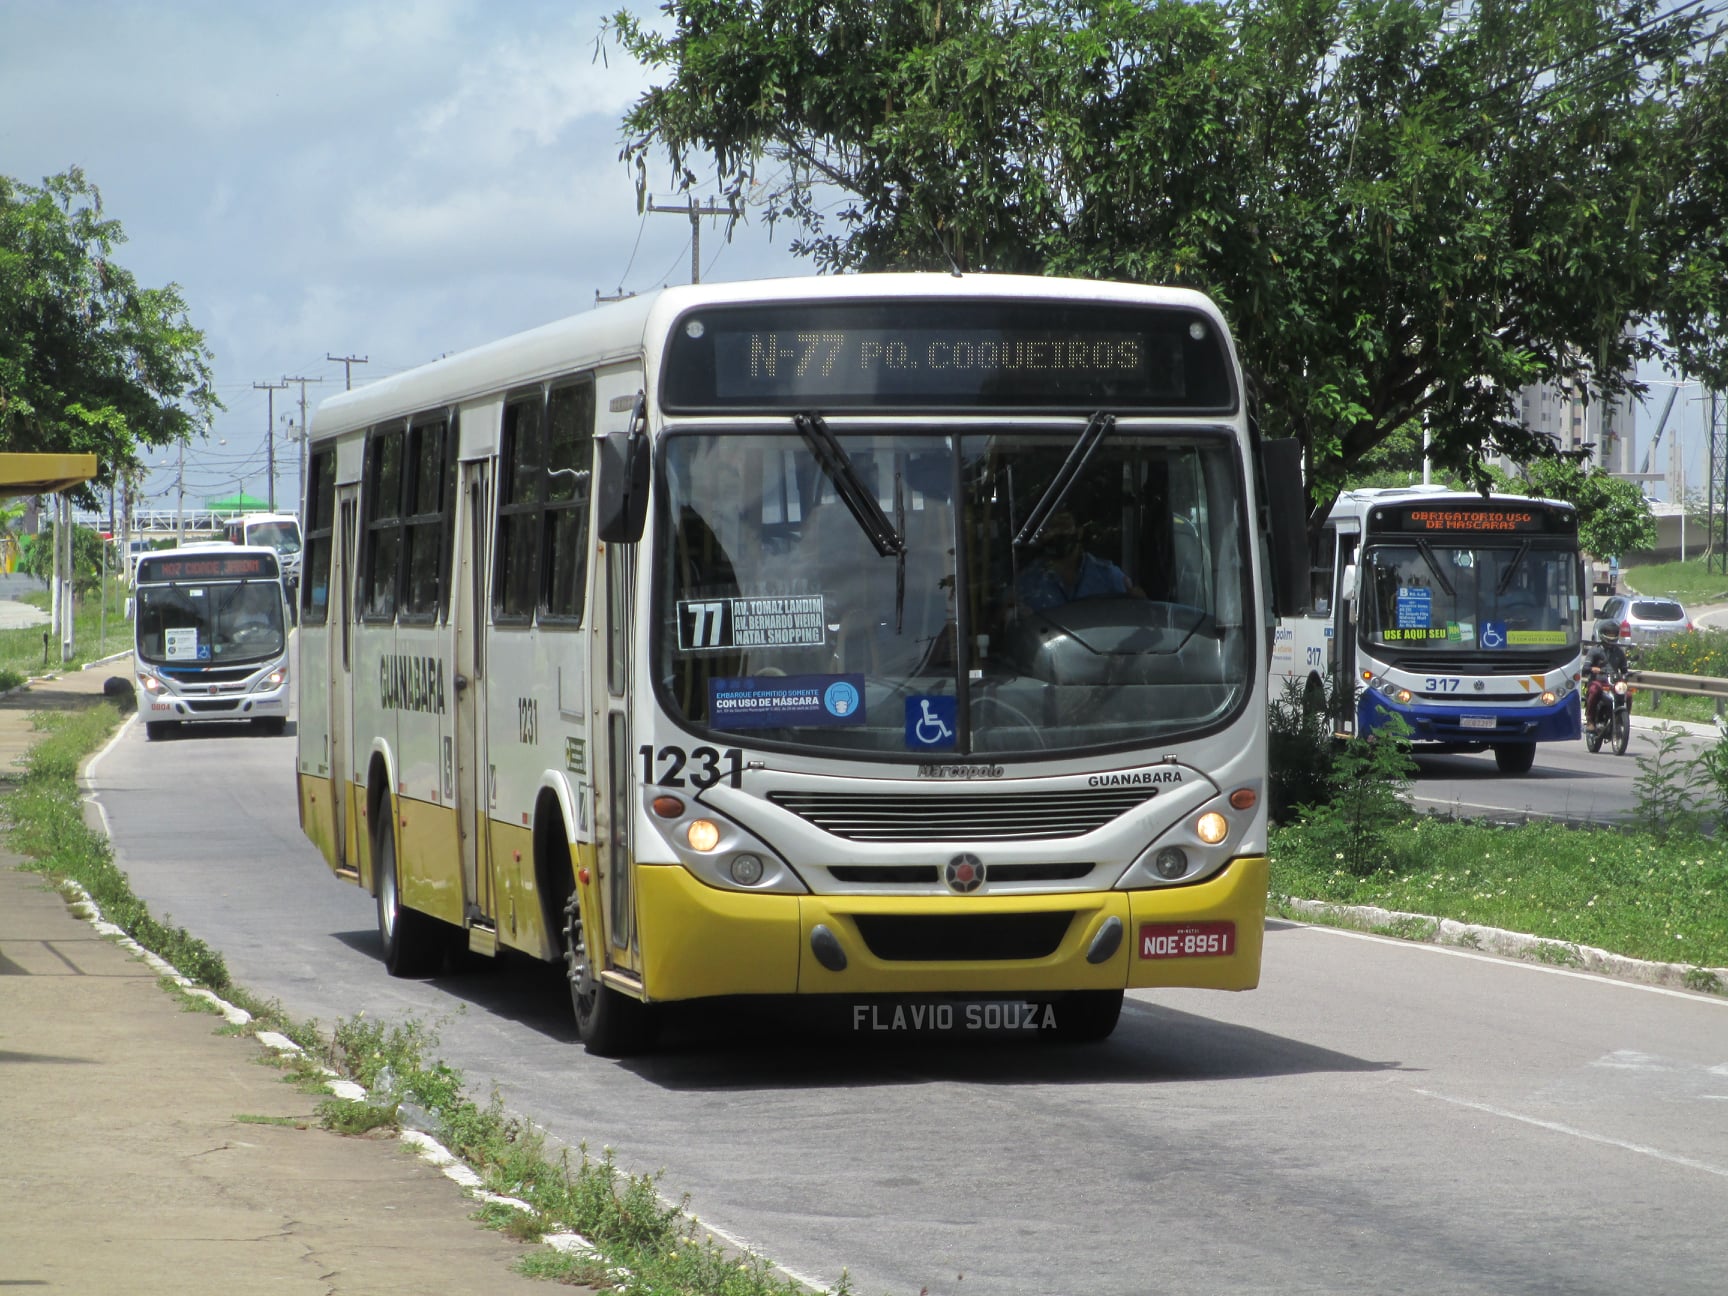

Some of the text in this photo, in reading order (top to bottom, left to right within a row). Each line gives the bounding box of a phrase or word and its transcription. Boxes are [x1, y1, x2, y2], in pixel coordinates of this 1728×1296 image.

[751, 334, 1138, 377] N-77 PQ. COQUEIROS
[1411, 511, 1531, 522] OBRIGATORIO USO
[1426, 520, 1516, 529] DE MASCARAS
[734, 598, 821, 616] AV. TOMAZ LANDIM
[687, 602, 723, 647] 77
[735, 613, 822, 630] AV. BERNARDO VIEIRA
[736, 628, 820, 645] NATAL SHOPPING
[1384, 629, 1446, 640] USE AQUI SEU
[1306, 646, 1322, 666] 317
[380, 654, 445, 715] GUANABARA
[1425, 678, 1460, 692] 317
[716, 695, 820, 708] COM USO DE MÁSCARA
[752, 690, 787, 698] PERMITIDO
[788, 689, 819, 697] SOMENTE
[518, 697, 539, 745] 1231
[639, 745, 743, 789] 1231
[917, 765, 1005, 780] Marcopolo
[1088, 772, 1182, 787] GUANABARA
